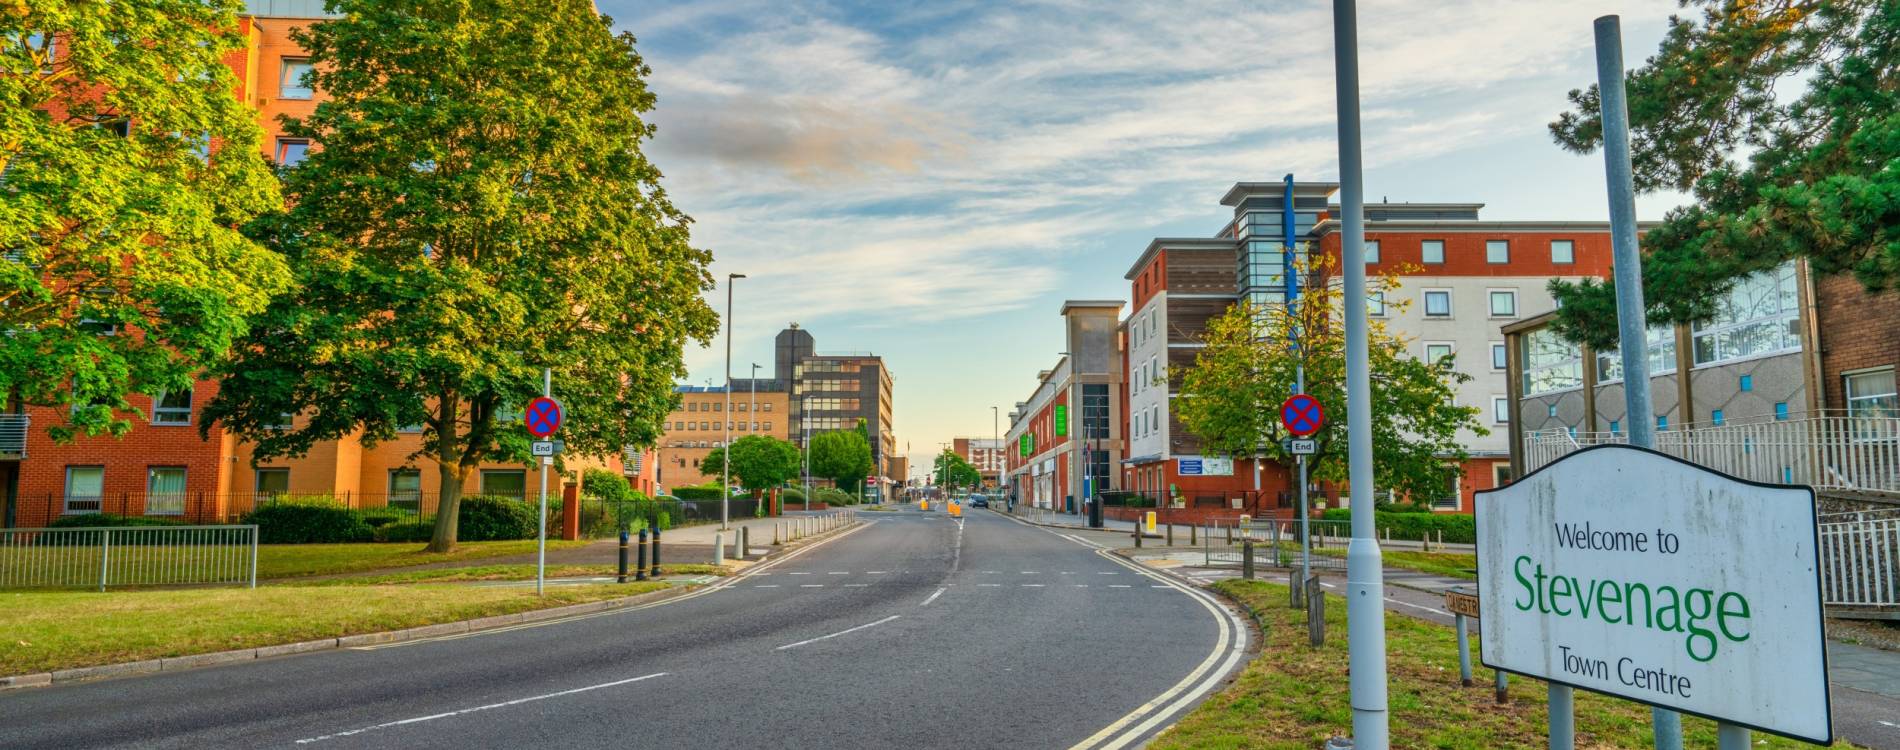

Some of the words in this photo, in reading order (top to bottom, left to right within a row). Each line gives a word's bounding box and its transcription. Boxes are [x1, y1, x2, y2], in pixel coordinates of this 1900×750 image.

[1555, 521, 1648, 552] Welcome
[1656, 529, 1679, 554] to
[1514, 555, 1751, 662] Stevenage
[1558, 645, 1609, 681] Town
[1617, 657, 1691, 698] Centre
